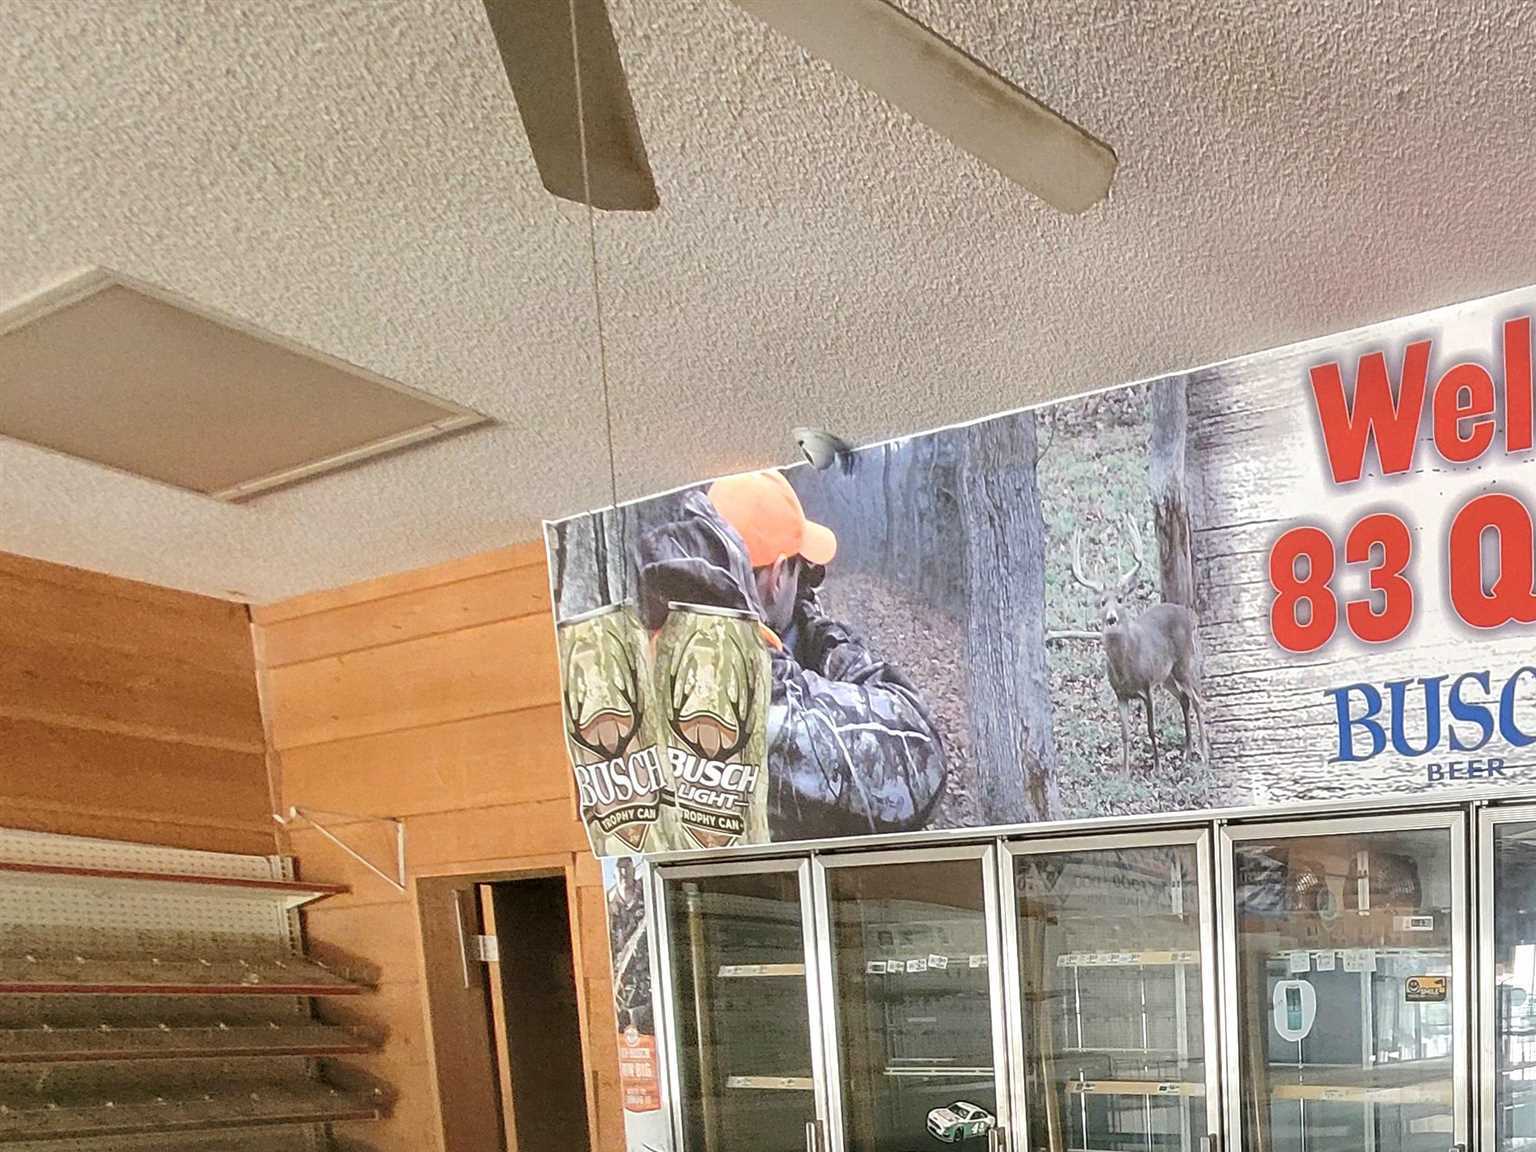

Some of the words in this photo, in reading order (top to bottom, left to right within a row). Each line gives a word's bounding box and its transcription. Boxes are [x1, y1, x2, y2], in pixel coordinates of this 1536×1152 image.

[1268, 512, 1413, 653] 83
[575, 744, 667, 807] BUSCH
[667, 746, 759, 793] BUSCH
[1427, 758, 1506, 782] BEER
[677, 783, 737, 809] LIGHT
[602, 811, 635, 830] TROPHY
[637, 808, 656, 819] CAN
[718, 820, 739, 831] CAN
